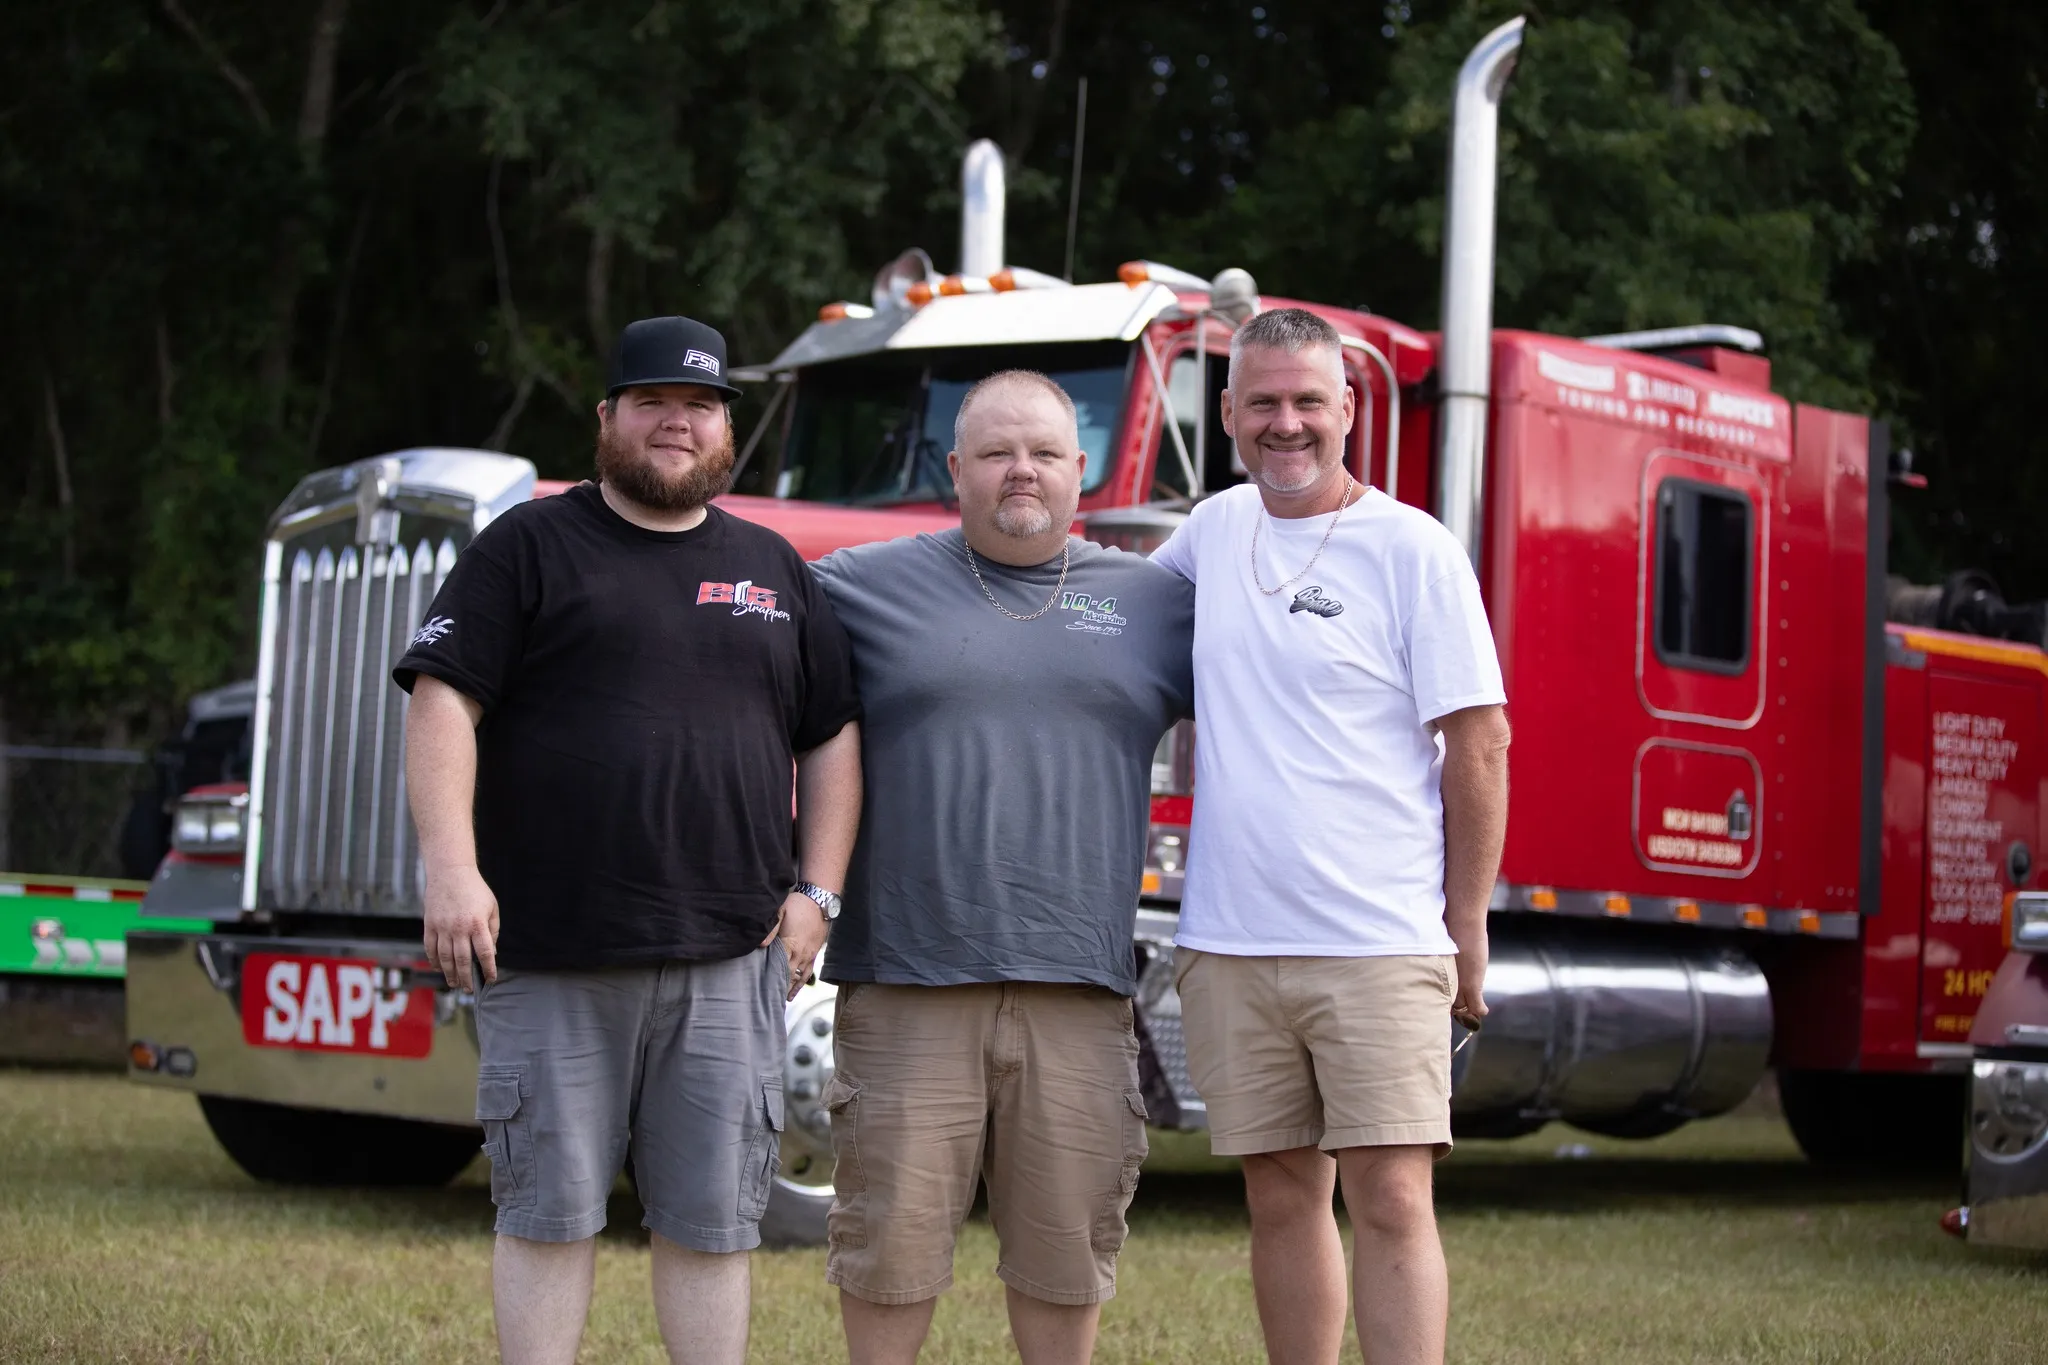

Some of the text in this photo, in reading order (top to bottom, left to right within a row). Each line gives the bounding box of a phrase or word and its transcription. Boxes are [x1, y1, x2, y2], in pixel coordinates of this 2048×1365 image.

[687, 352, 719, 373] FSM
[1634, 403, 1670, 428] AND
[1675, 412, 1756, 447] RECOVERY
[1061, 592, 1117, 614] 10-4
[1066, 621, 1103, 634] Since
[1083, 610, 1127, 626] Magazine
[1933, 711, 2006, 738] LIGHT DUTY
[1933, 733, 2019, 762] MEDIUM DUTY
[1933, 755, 2008, 781] HEAVY DUTY
[1944, 968, 1965, 997] 24
[263, 960, 409, 1050] SAPP
